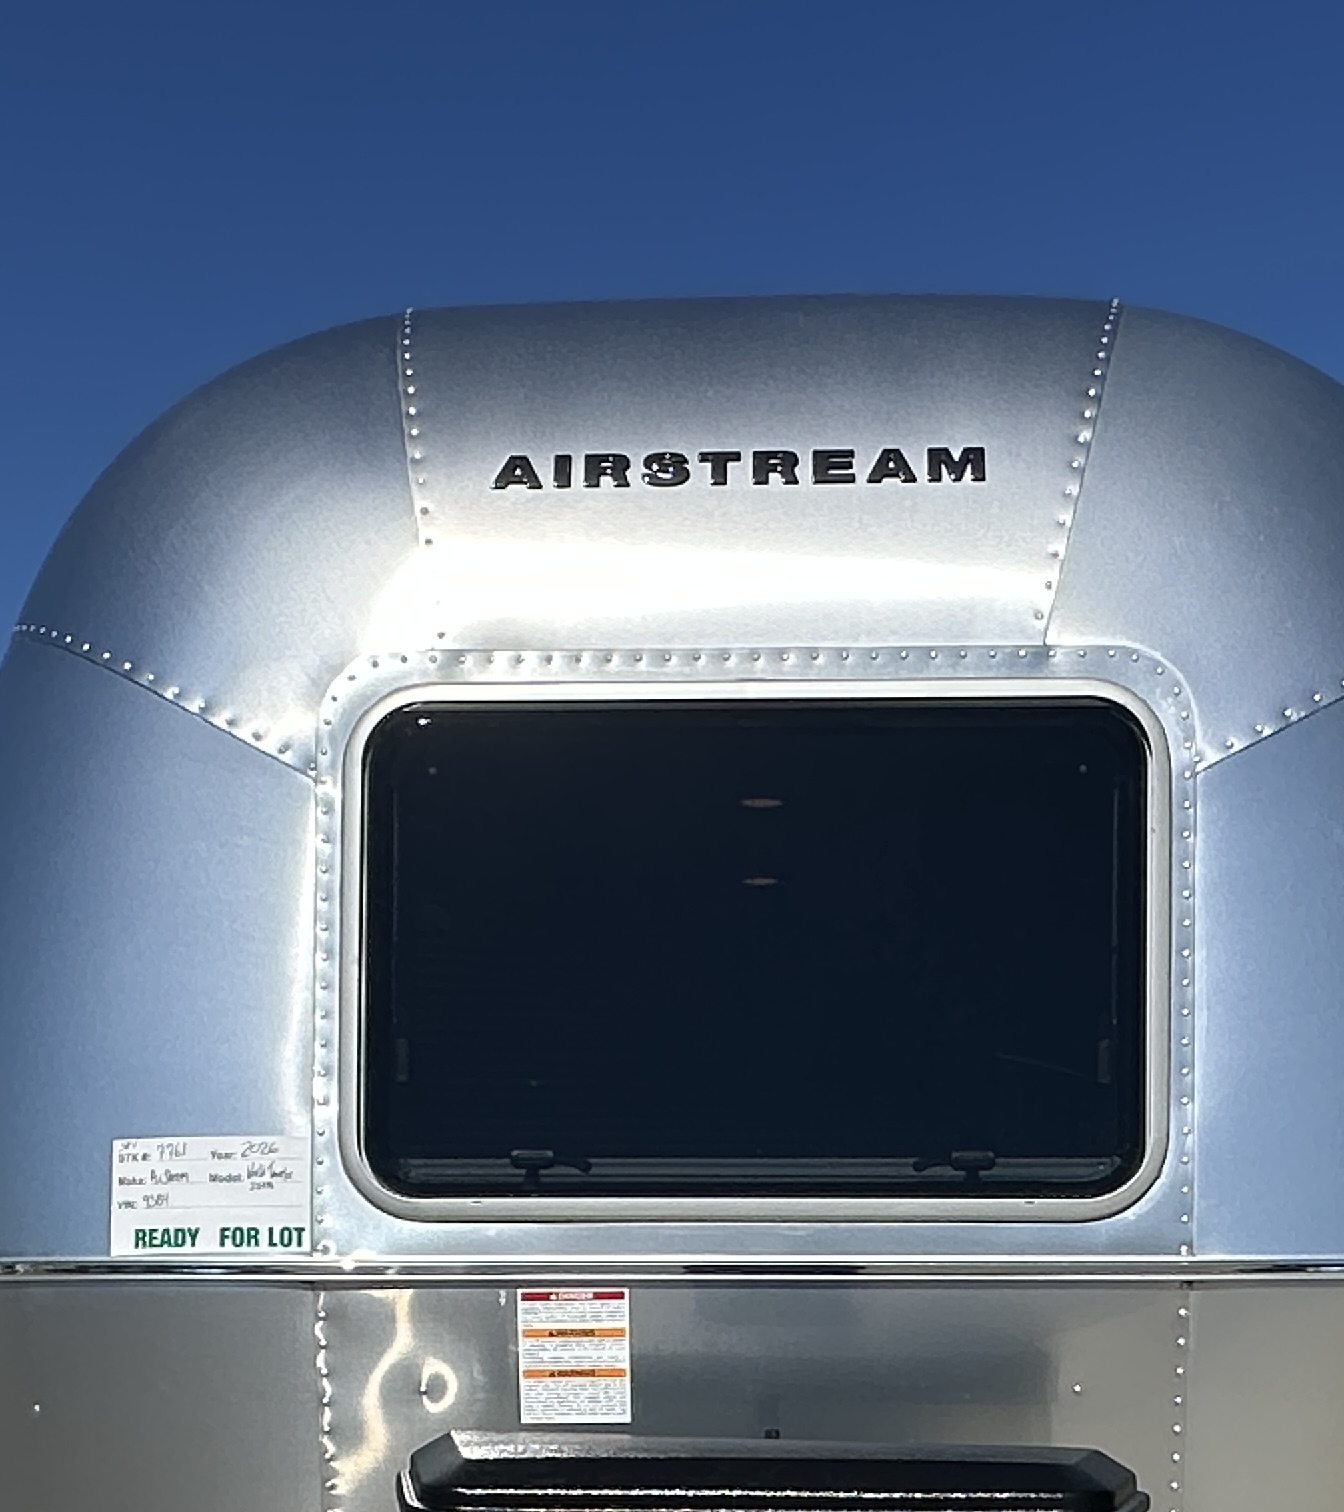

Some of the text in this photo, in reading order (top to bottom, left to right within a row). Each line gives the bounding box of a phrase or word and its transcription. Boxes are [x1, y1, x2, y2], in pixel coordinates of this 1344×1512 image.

[492, 446, 987, 489] AIRSTREAM
[240, 1140, 280, 1158] 2026
[134, 1226, 306, 1249] READY FOR LOT
